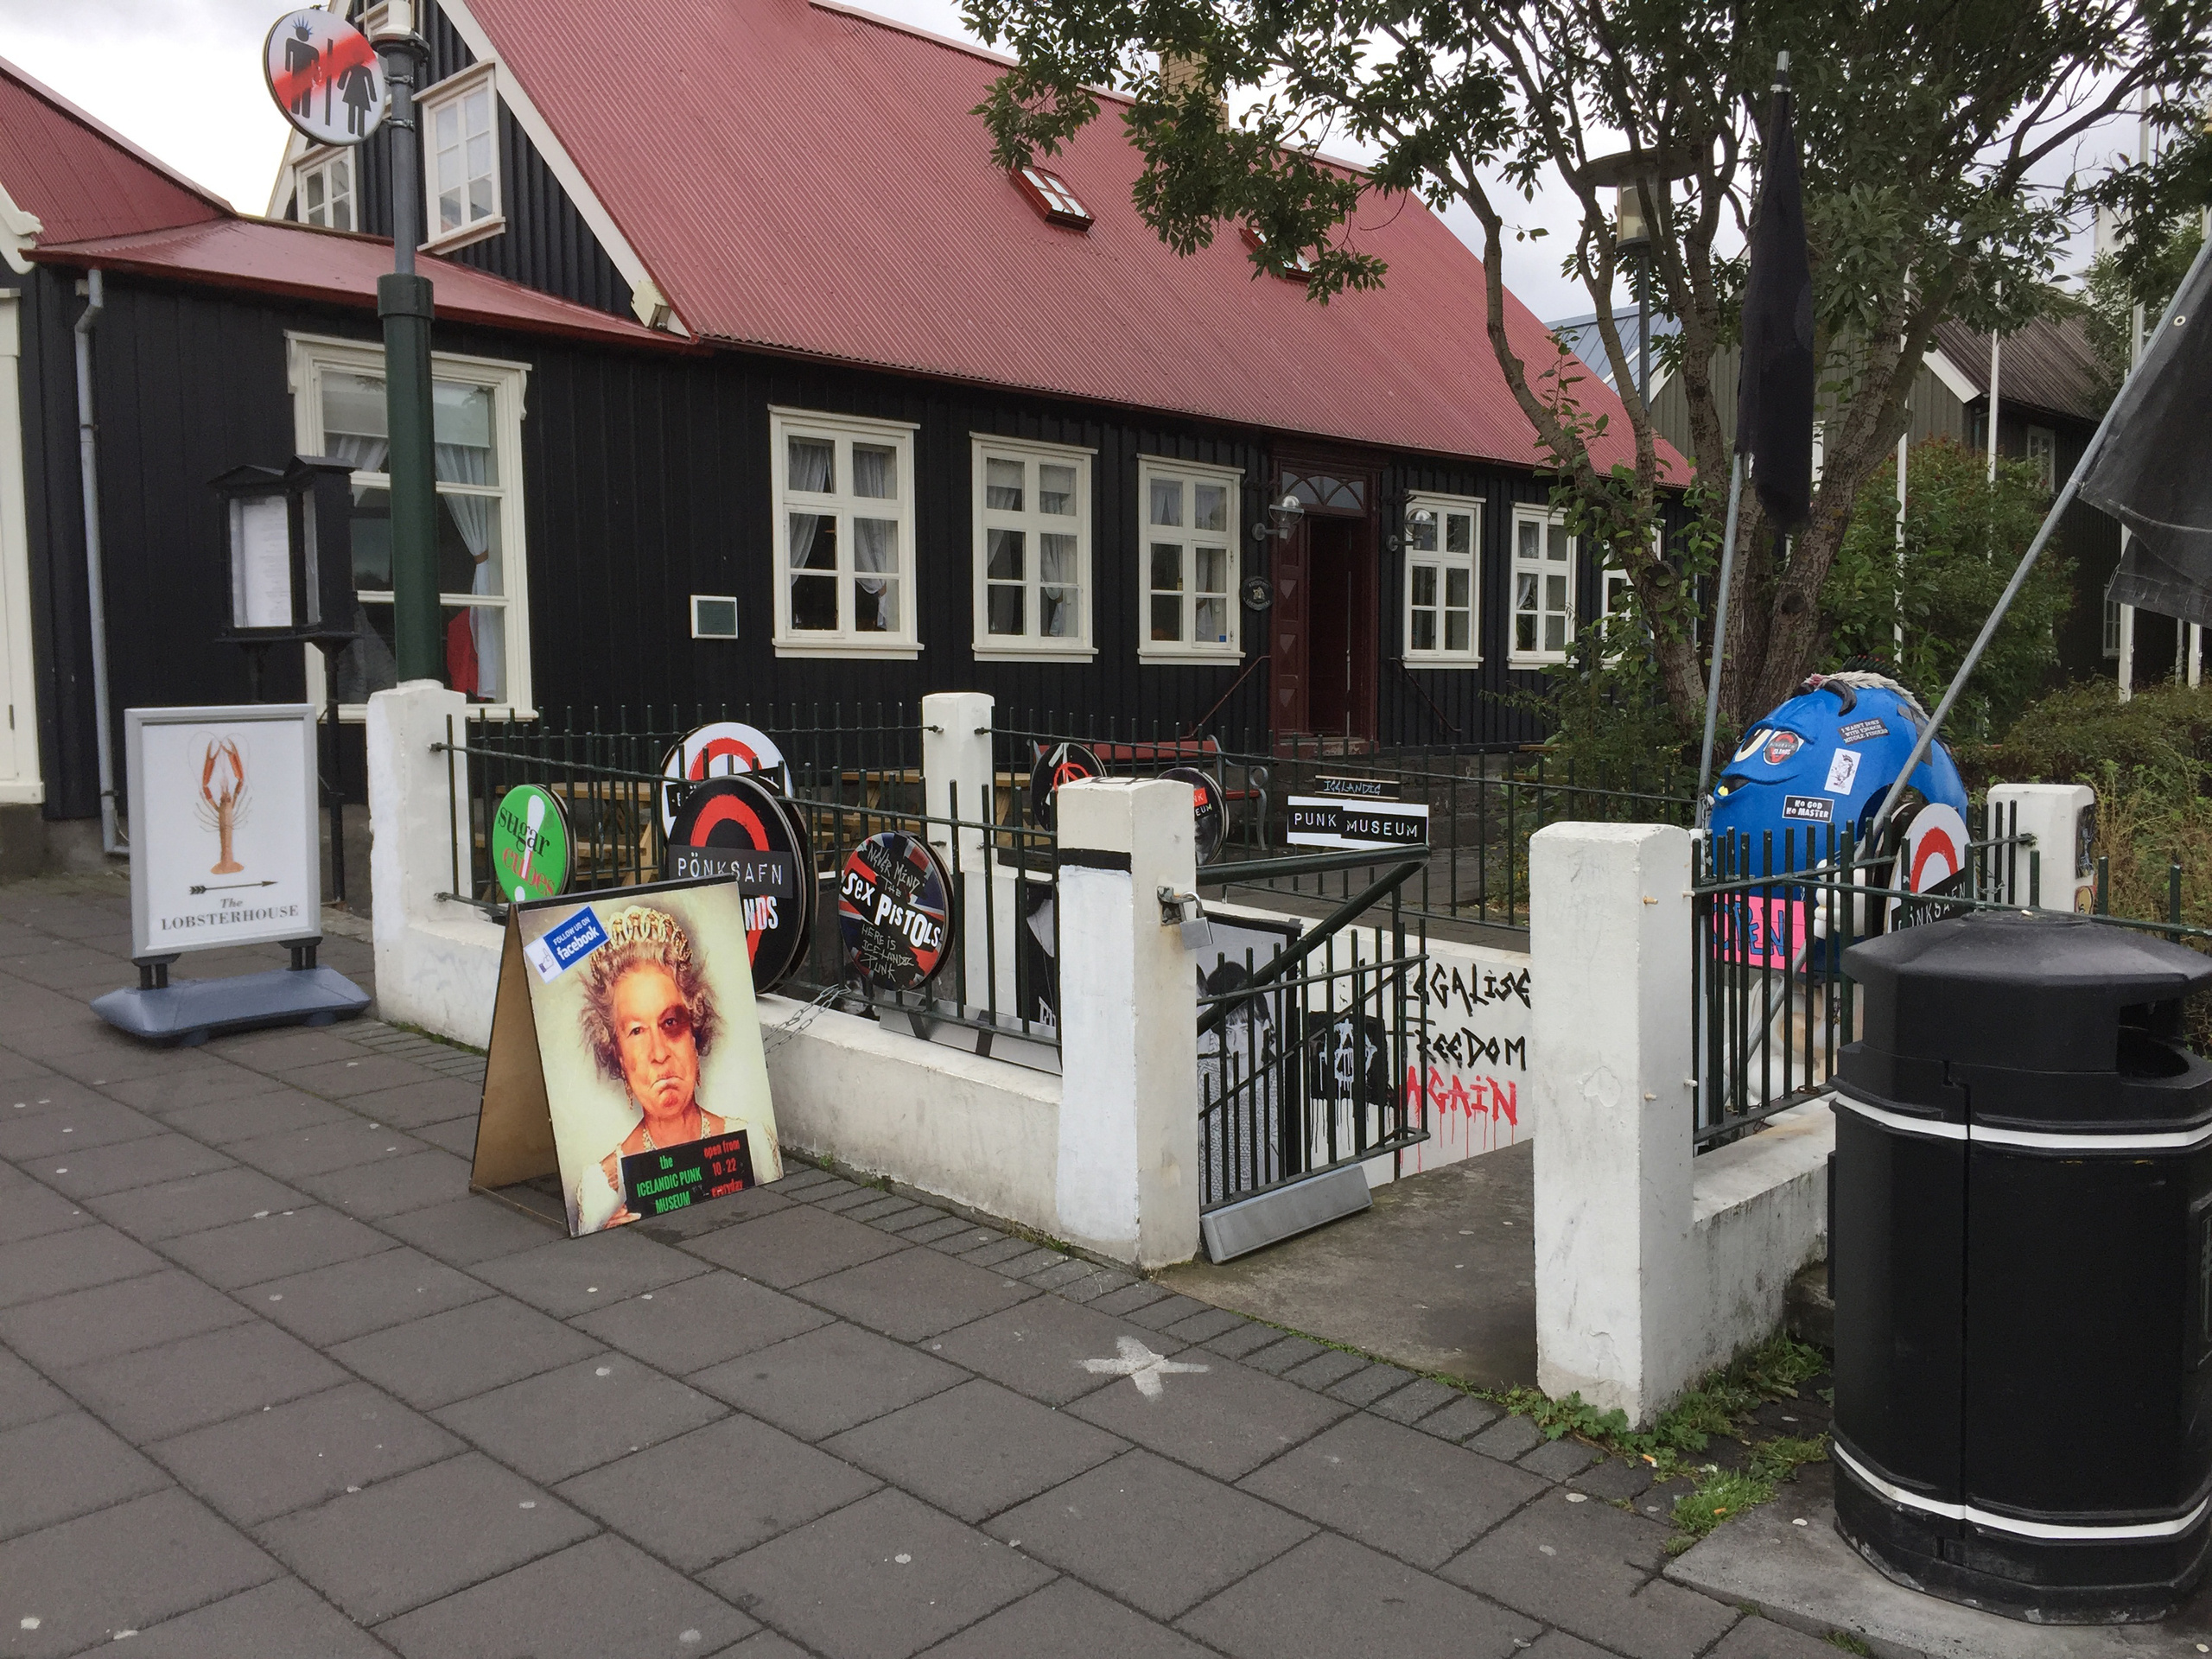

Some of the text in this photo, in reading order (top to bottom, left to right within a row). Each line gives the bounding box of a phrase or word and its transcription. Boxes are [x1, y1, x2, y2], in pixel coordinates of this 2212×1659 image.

[1195, 803, 1212, 817] EUM
[1797, 807, 1829, 818] MASTER
[1807, 801, 1823, 810] GOD
[498, 806, 550, 858] sugar
[1294, 811, 1418, 838] PUNK MUSEUM
[677, 851, 783, 886] PÖNKSAFN
[867, 842, 892, 877] NEVER
[877, 874, 903, 898] THE
[220, 898, 243, 908] The
[161, 905, 299, 931] LOBSTERHOUSE
[553, 917, 591, 946] FOLLOW US ON
[556, 925, 601, 961] facebook
[861, 924, 884, 946] HERE
[861, 953, 897, 983] PUNK
[703, 1138, 741, 1160] open from
[659, 1154, 673, 1170] the
[712, 1160, 722, 1177] 10
[727, 1158, 737, 1173] 22
[636, 1166, 702, 1198] ICELANDIC PUNK
[710, 1178, 744, 1198] everyday
[655, 1191, 691, 1214] MUSEUM
